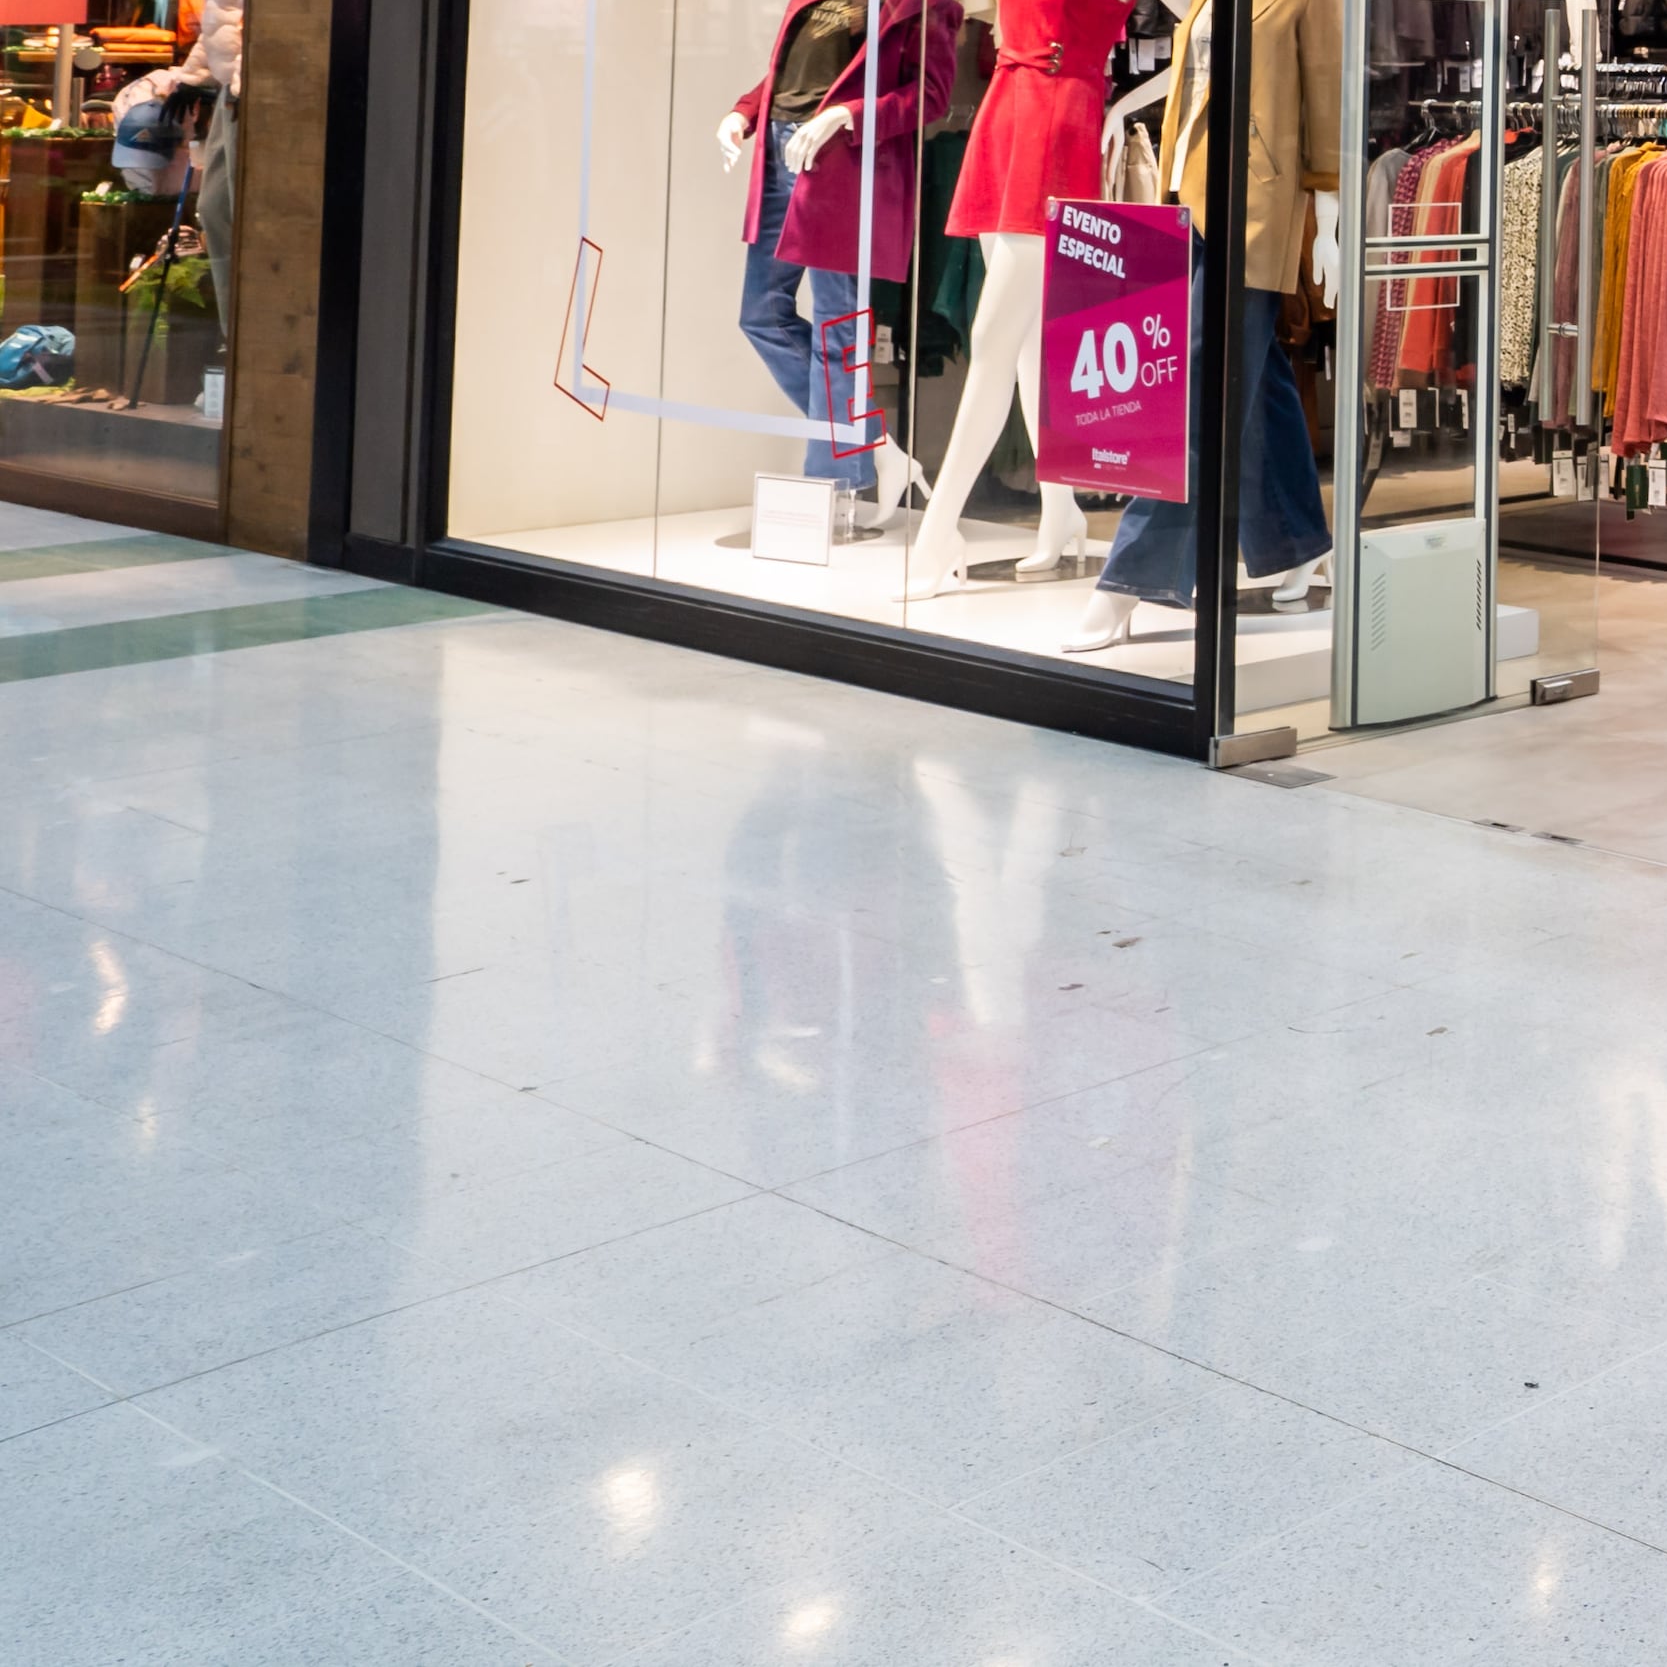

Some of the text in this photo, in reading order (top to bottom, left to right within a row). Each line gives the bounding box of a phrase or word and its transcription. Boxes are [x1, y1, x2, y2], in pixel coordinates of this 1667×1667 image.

[1061, 204, 1122, 245] EVENTO
[1056, 233, 1127, 279] ESPECIAL
[1139, 355, 1179, 388] OFF
[1075, 399, 1142, 427] TODA LA TIENDA
